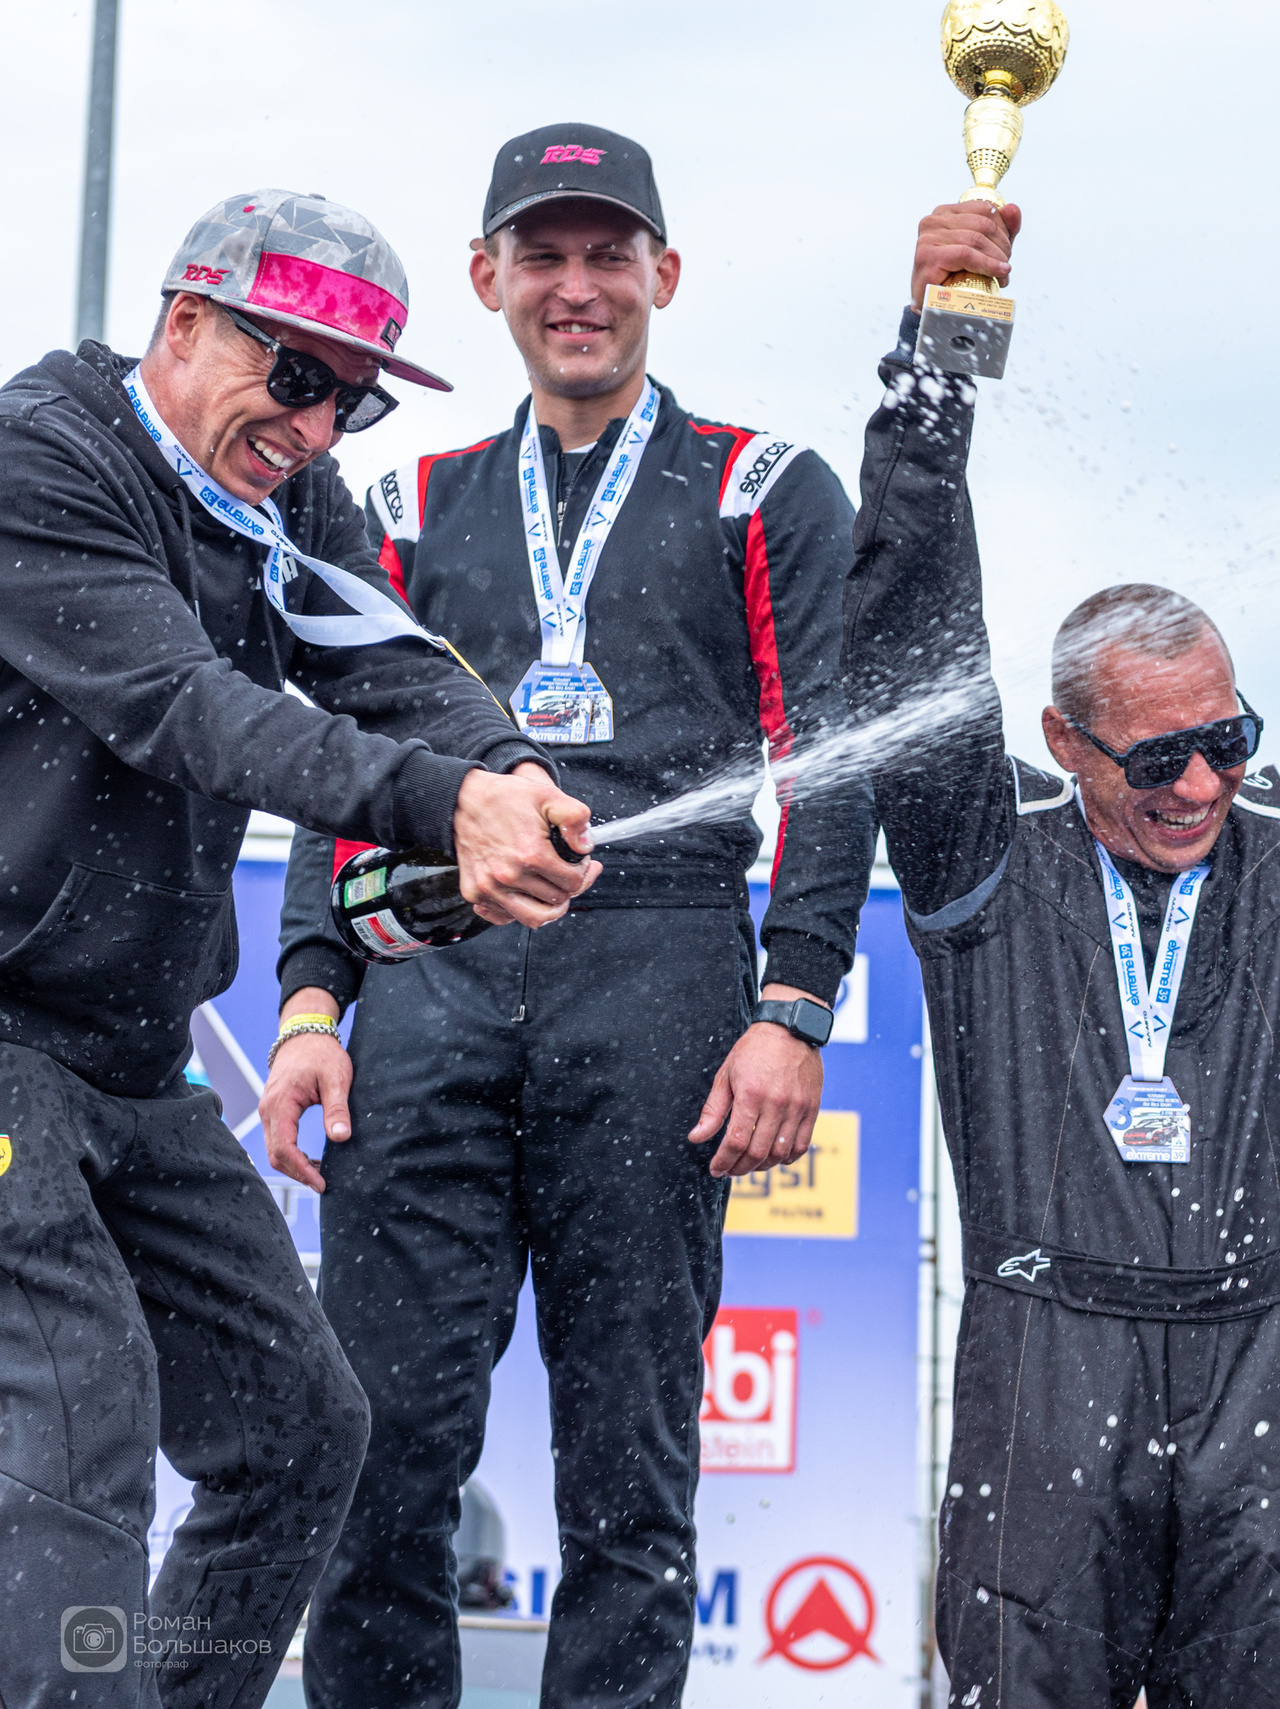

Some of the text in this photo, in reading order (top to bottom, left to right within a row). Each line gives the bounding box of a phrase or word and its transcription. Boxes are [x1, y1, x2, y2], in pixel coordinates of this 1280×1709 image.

[540, 144, 605, 165] RDS
[181, 263, 230, 285] RDS
[740, 442, 787, 493] sparco
[202, 488, 218, 506] 39
[384, 471, 403, 519] parco
[1120, 944, 1132, 958] 39
[1161, 940, 1180, 986] extreme
[1125, 959, 1140, 1006] extreme
[1157, 989, 1169, 1002] 39
